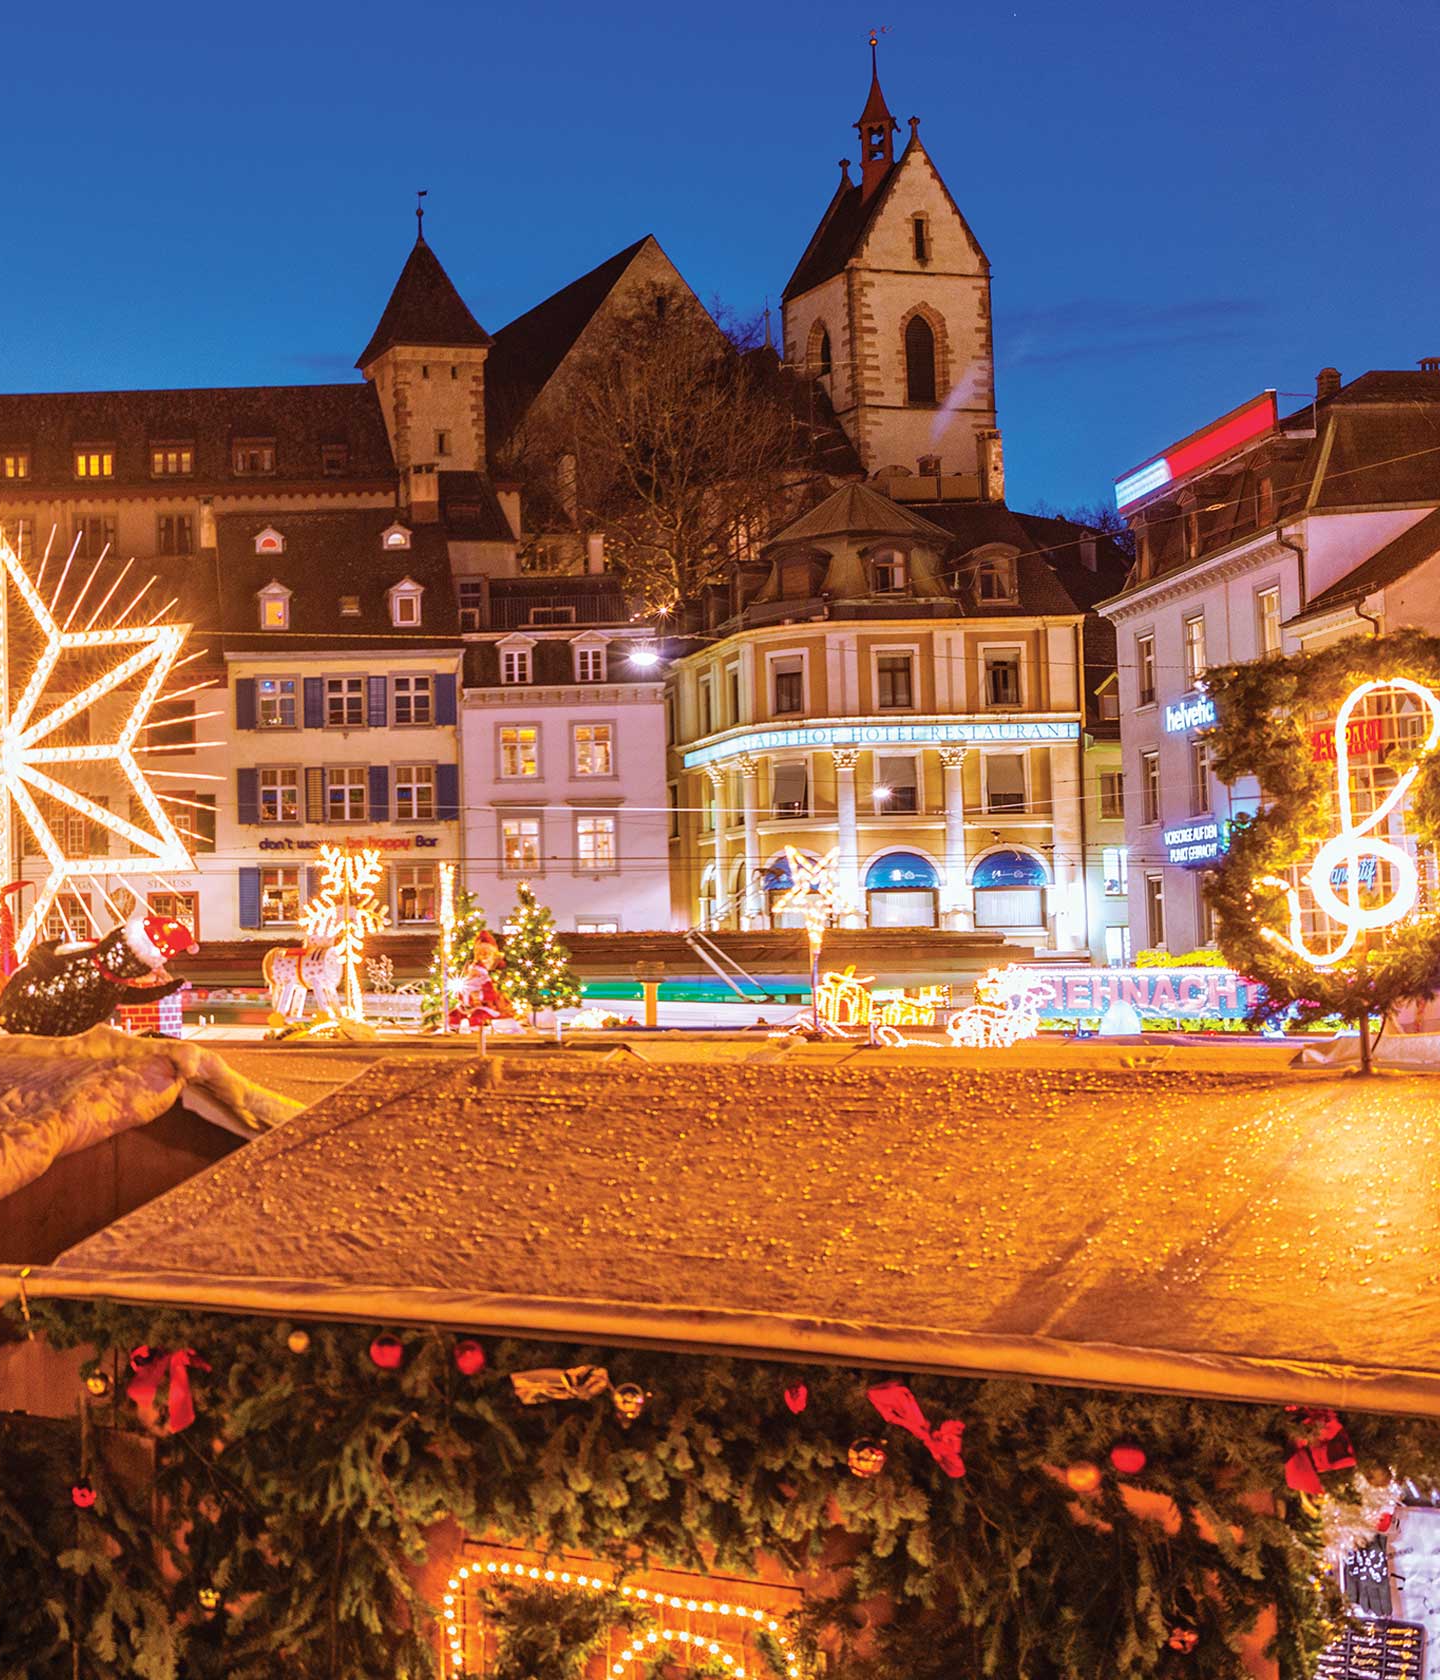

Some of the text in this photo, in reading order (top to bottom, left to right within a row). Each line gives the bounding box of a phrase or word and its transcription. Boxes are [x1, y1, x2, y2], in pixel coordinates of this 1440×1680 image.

[851, 726, 921, 742] HOTEL
[930, 723, 1078, 741] RESTAURANT
[258, 837, 293, 850] don't
[345, 836, 362, 850] be
[368, 835, 411, 850] happy
[415, 834, 439, 848] Bar
